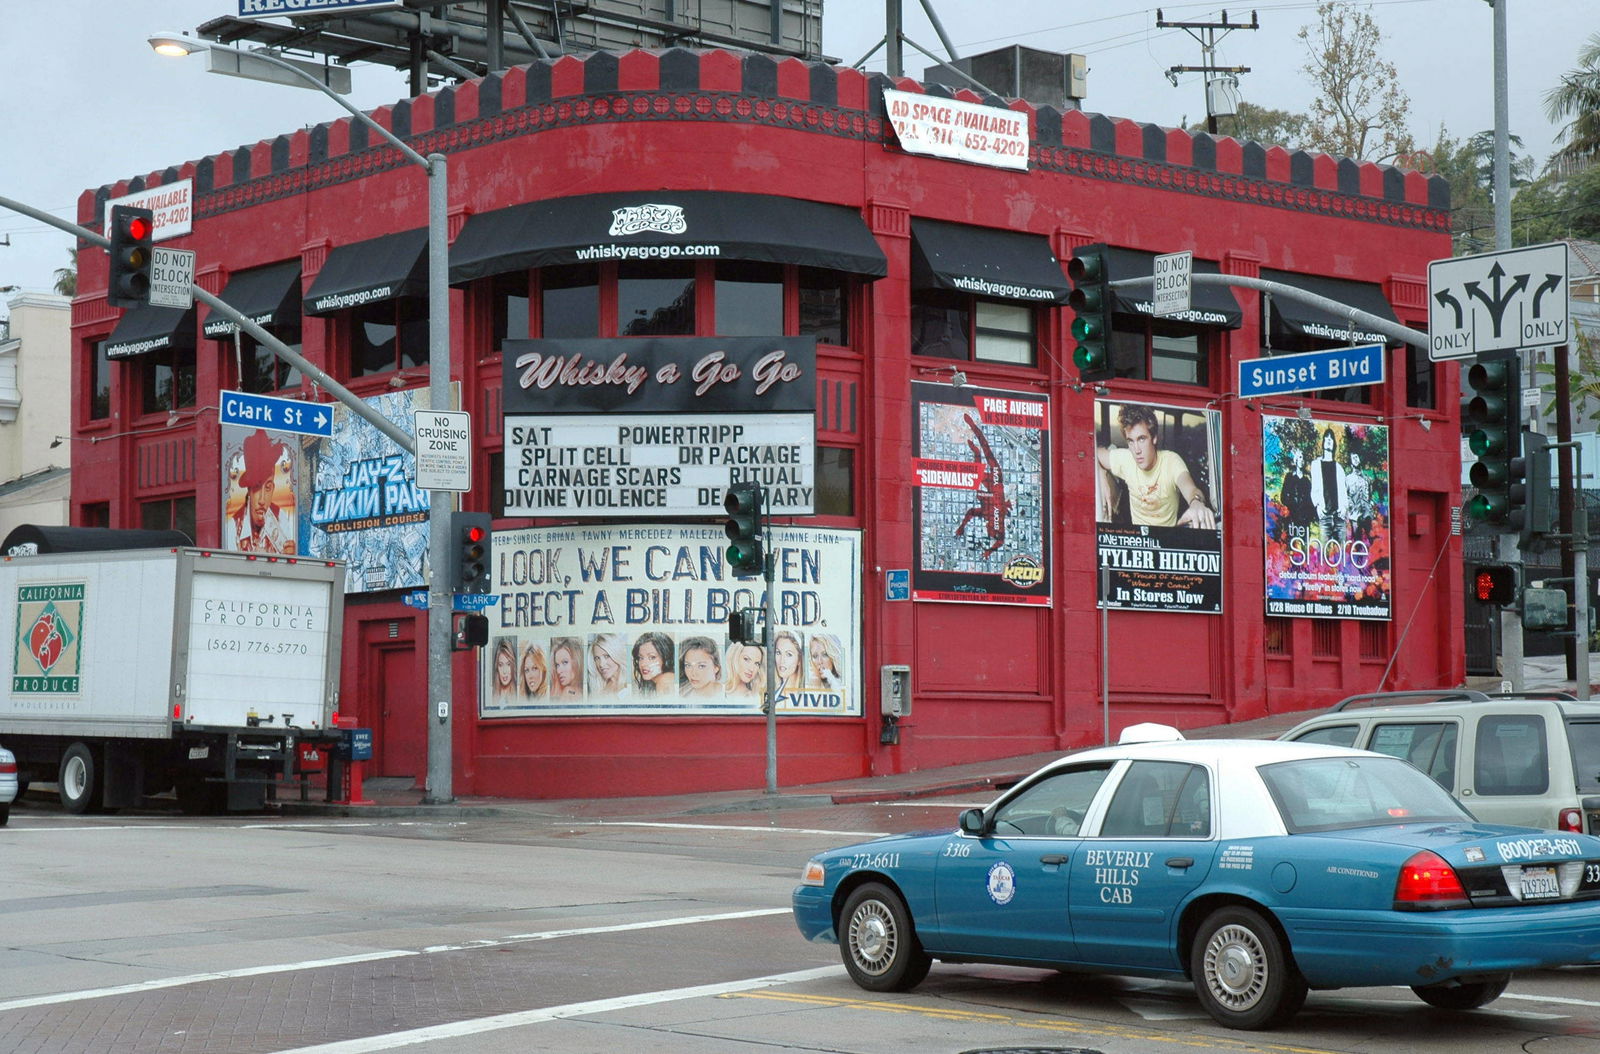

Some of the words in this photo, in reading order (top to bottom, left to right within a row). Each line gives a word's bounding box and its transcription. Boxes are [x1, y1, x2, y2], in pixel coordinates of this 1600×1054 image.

[892, 100, 909, 118] AD
[912, 103, 951, 125] SPACE
[954, 111, 1020, 137] AVAILABLE
[965, 132, 1025, 157] 652-4202
[147, 188, 188, 211] AVAILABLE
[154, 251, 169, 265] DO
[172, 254, 193, 268] NOT
[576, 244, 720, 260] whiskyagogo.com
[1156, 260, 1169, 274] DO
[1171, 256, 1189, 271] NOT
[153, 267, 191, 285] BLOCK
[1156, 273, 1188, 291] BLOCK
[151, 282, 190, 296] INTERSECTION
[953, 276, 1055, 300] whiskyagogo.com
[315, 286, 391, 311] whiskyagogo.com
[1524, 319, 1564, 339] ONLY
[107, 335, 169, 358] whiskyagogo.com
[1434, 332, 1472, 351] ONLY
[515, 352, 648, 395] Whisky
[655, 362, 682, 384] a
[692, 351, 741, 396] Go
[752, 350, 802, 395] Go
[1251, 361, 1317, 388] Sunset
[1328, 355, 1370, 379] Blvd
[226, 400, 273, 422] Clark
[283, 407, 303, 426] St
[983, 398, 1008, 414] PAGE
[1010, 400, 1044, 417] AVENUE
[434, 417, 450, 427] NO
[418, 428, 467, 440] CRUISING
[512, 427, 551, 445] SAT
[618, 425, 744, 444] POWERTRIPP
[429, 440, 458, 451] ZONE
[521, 448, 577, 466] SPLIT
[583, 447, 631, 466] CELL
[678, 446, 704, 465] DR
[709, 445, 801, 464] PACKAGE
[344, 457, 405, 488] JAY-Z
[518, 468, 610, 487] CARNAGE
[616, 466, 681, 486] SCARS
[729, 466, 802, 487] RITUAL
[311, 486, 380, 521] LINKIN
[504, 488, 567, 508] DIVINE
[574, 487, 667, 507] VIOLENCE
[327, 518, 380, 532] COLLISION
[385, 513, 425, 526] COURSE
[1288, 522, 1306, 537] the
[513, 533, 542, 545] SUNRISE
[546, 531, 576, 543] BRIANA
[582, 530, 612, 541] TAWNY
[619, 528, 672, 540] MERCEDEZ
[680, 529, 725, 540] MALEZIA
[778, 531, 809, 543] JANINE
[813, 533, 840, 545] JENNA
[1289, 526, 1369, 569] shore
[500, 547, 572, 588] LOOK,
[578, 545, 633, 583] WE
[645, 545, 725, 582] CAN
[1099, 547, 1155, 570] TYLER
[1159, 551, 1220, 573] HILTON
[19, 587, 83, 600] CALIFORNIA
[461, 595, 489, 605] CLARK
[1116, 587, 1130, 600] In
[1133, 588, 1174, 603] Stores
[1176, 590, 1204, 605] Now
[205, 599, 313, 617] CALIFORNIA
[501, 588, 584, 628] ERECT
[591, 589, 615, 625] A
[626, 588, 828, 628] BILLBOARD.
[1284, 602, 1306, 613] House
[1306, 603, 1314, 614] Of
[1314, 603, 1333, 614] Blues
[1352, 605, 1389, 616] Troubadour
[204, 612, 313, 630] PRODUCE
[207, 638, 241, 653] (562)
[247, 641, 307, 655] 776-5770
[14, 679, 78, 692] PRODUCE
[789, 693, 841, 708] VIVID
[942, 842, 972, 858] 3316
[1085, 849, 1154, 869] BEVERLY
[1496, 838, 1582, 863] (800)273-6611
[852, 852, 900, 869] 273-6611
[1095, 868, 1139, 887] HILLS
[1326, 866, 1337, 874] AIR
[1338, 866, 1379, 879] CONDITIONED
[1100, 886, 1133, 904] CAB
